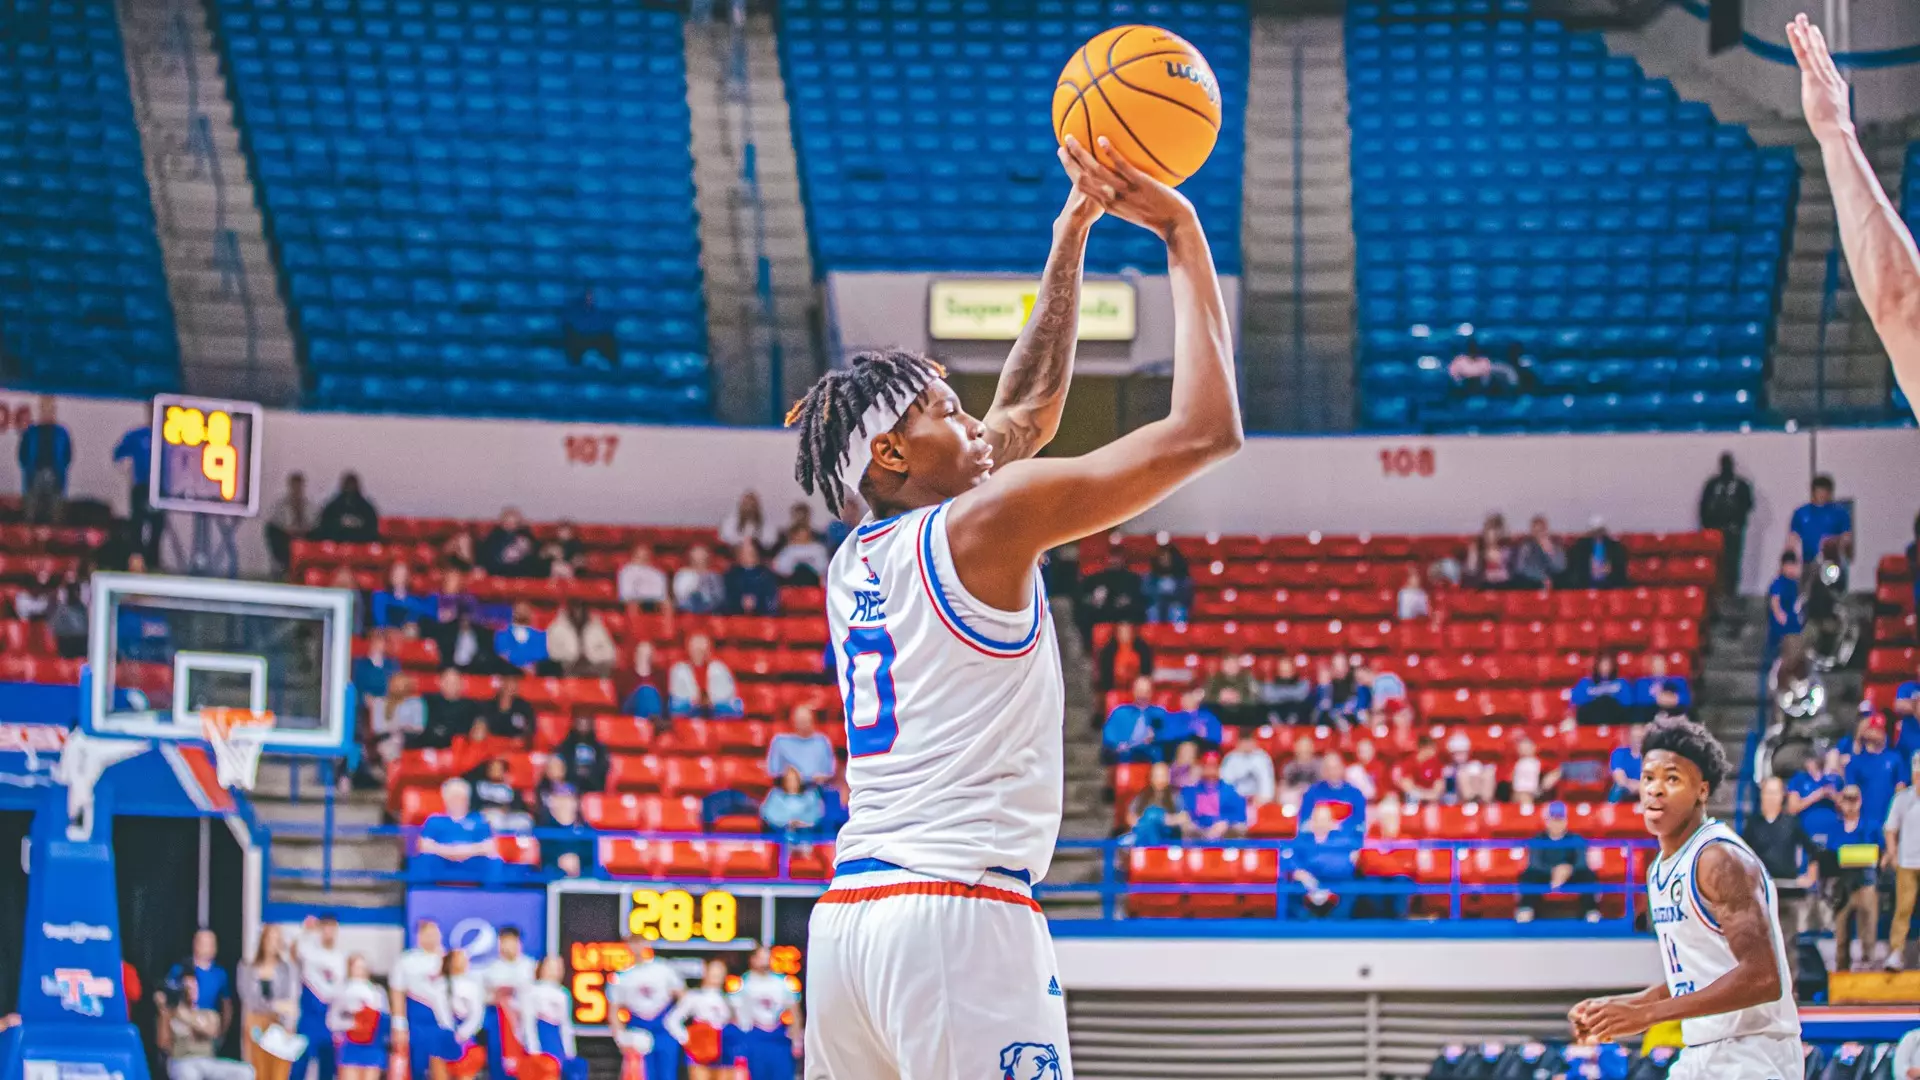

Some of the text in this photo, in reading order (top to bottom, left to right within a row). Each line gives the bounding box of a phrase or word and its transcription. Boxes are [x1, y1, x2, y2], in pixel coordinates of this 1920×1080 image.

[564, 436, 619, 466] 107
[1380, 448, 1435, 477] 108
[201, 444, 238, 501] 9
[629, 889, 737, 942] 28.8
